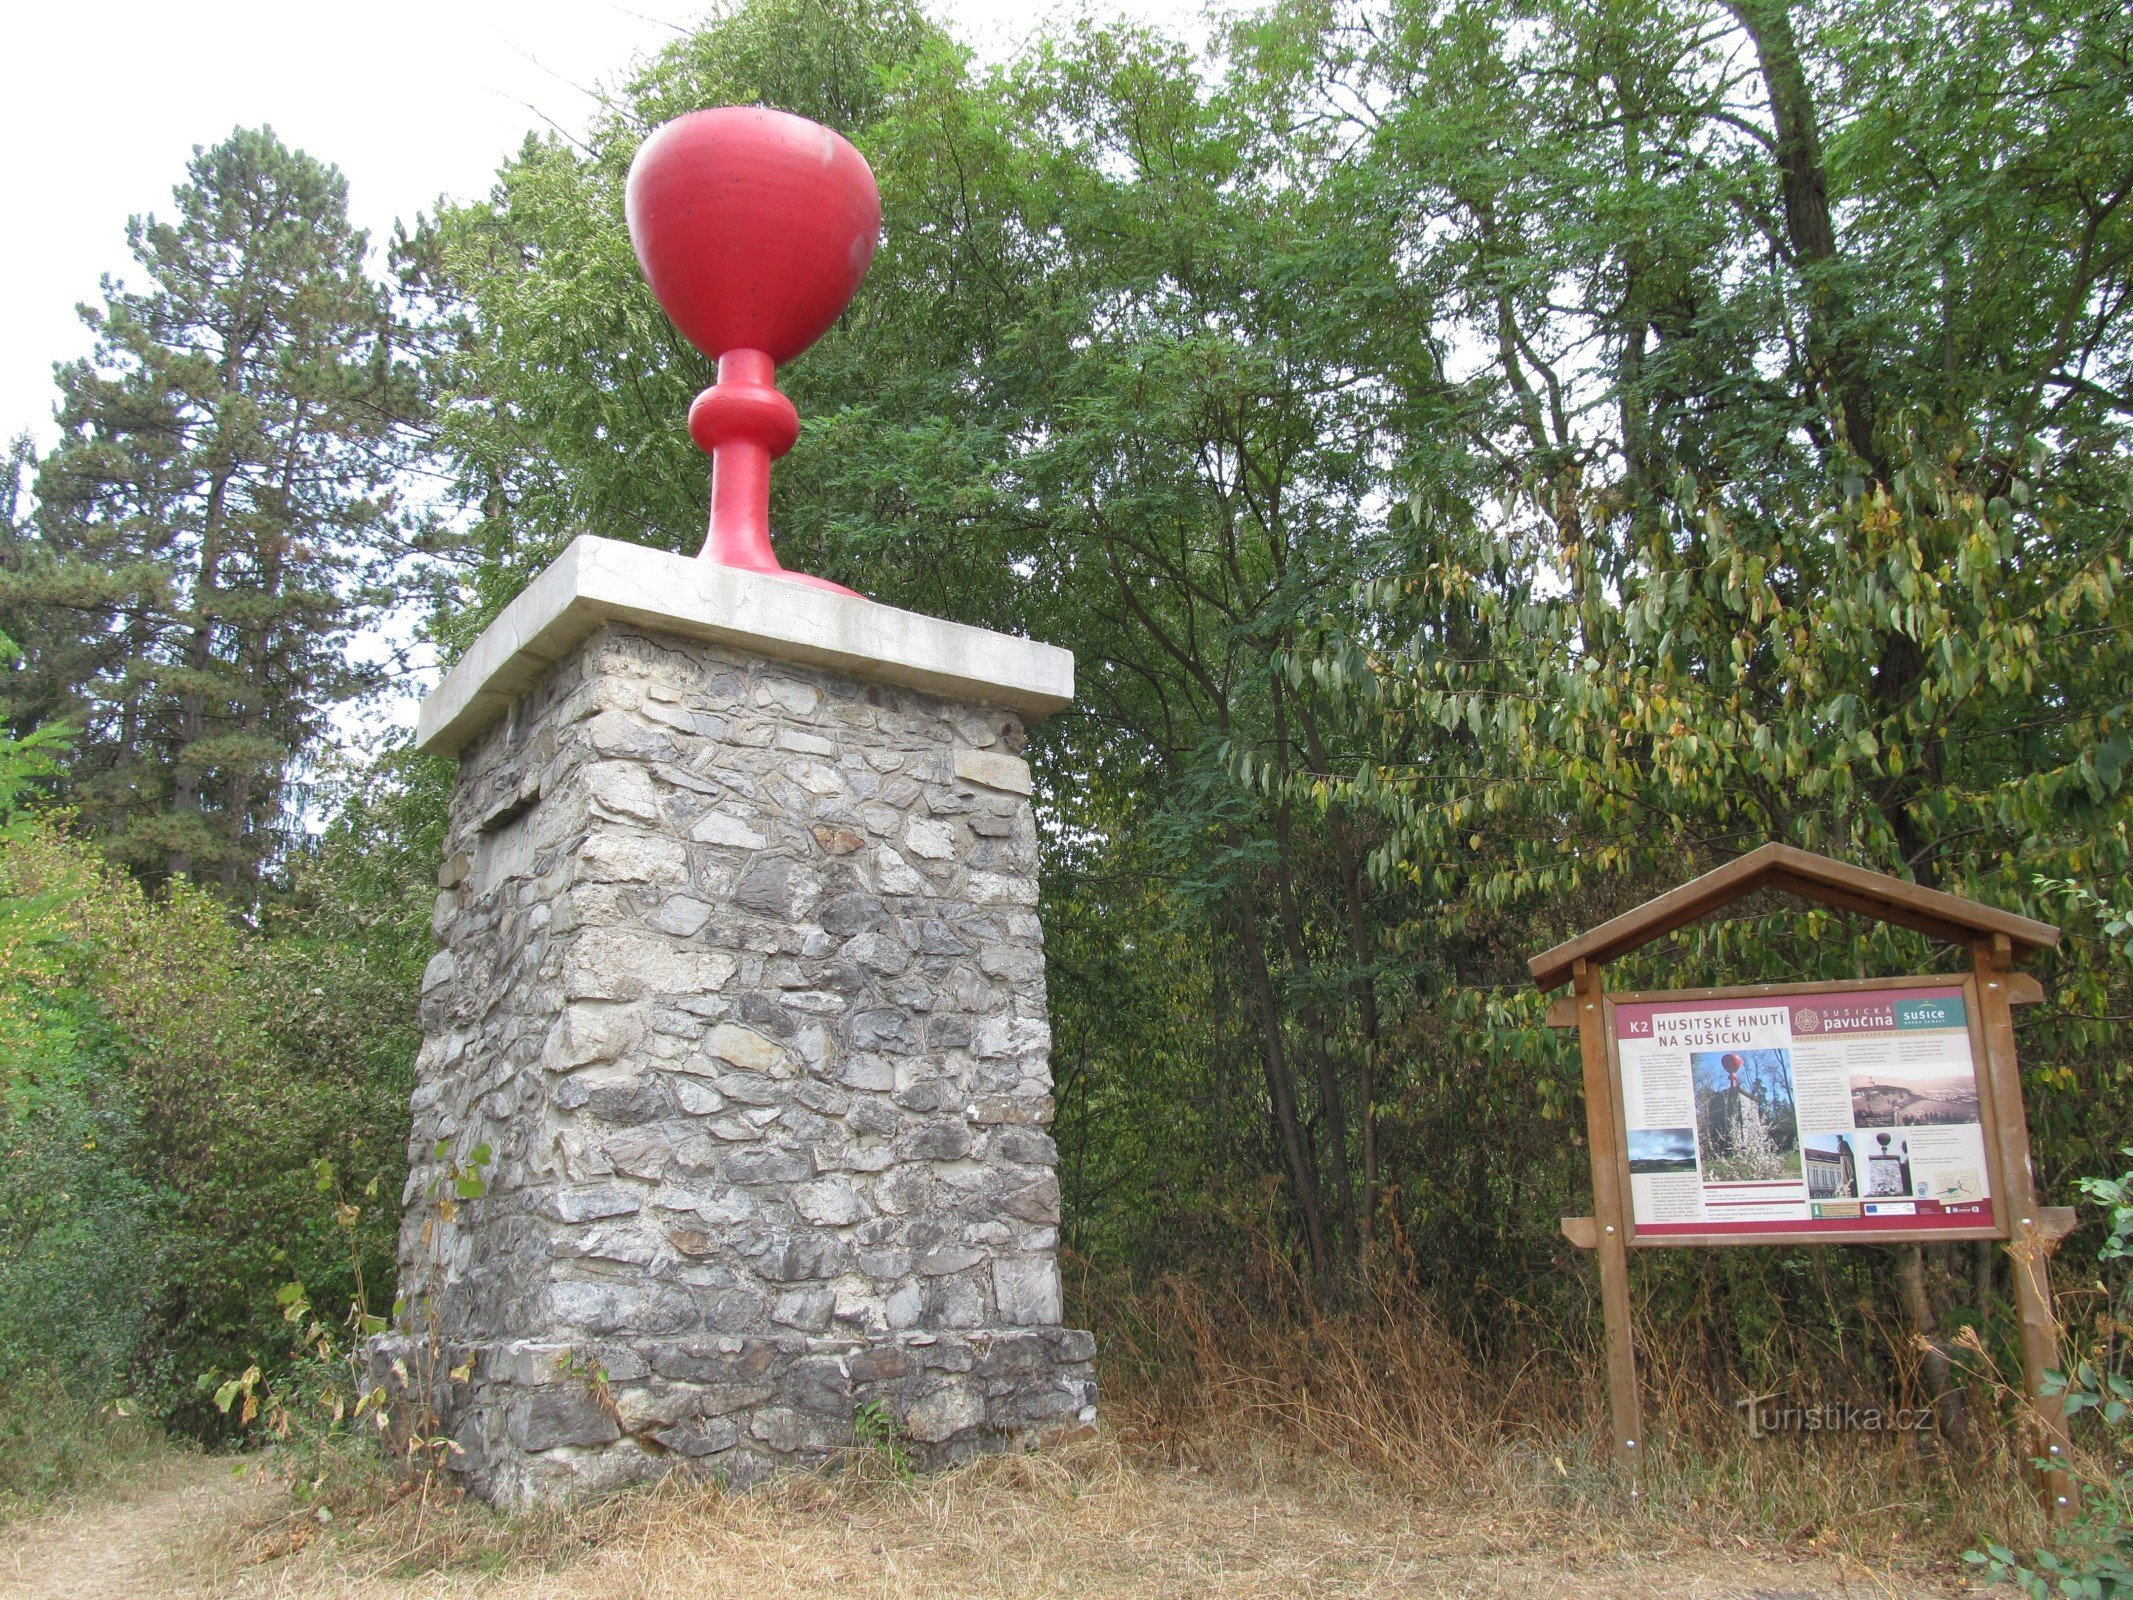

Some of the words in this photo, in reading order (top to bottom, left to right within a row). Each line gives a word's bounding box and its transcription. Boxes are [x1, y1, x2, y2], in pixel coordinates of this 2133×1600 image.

[1630, 1021, 1649, 1033] K2
[1657, 1014, 1732, 1031] HUSITSKÉ
[1738, 1011, 1785, 1027] HNUTÍ
[1823, 1015, 1894, 1032] pavučina
[1659, 1036, 1679, 1047] NA
[1684, 1031, 1751, 1046] SUŠICKU
